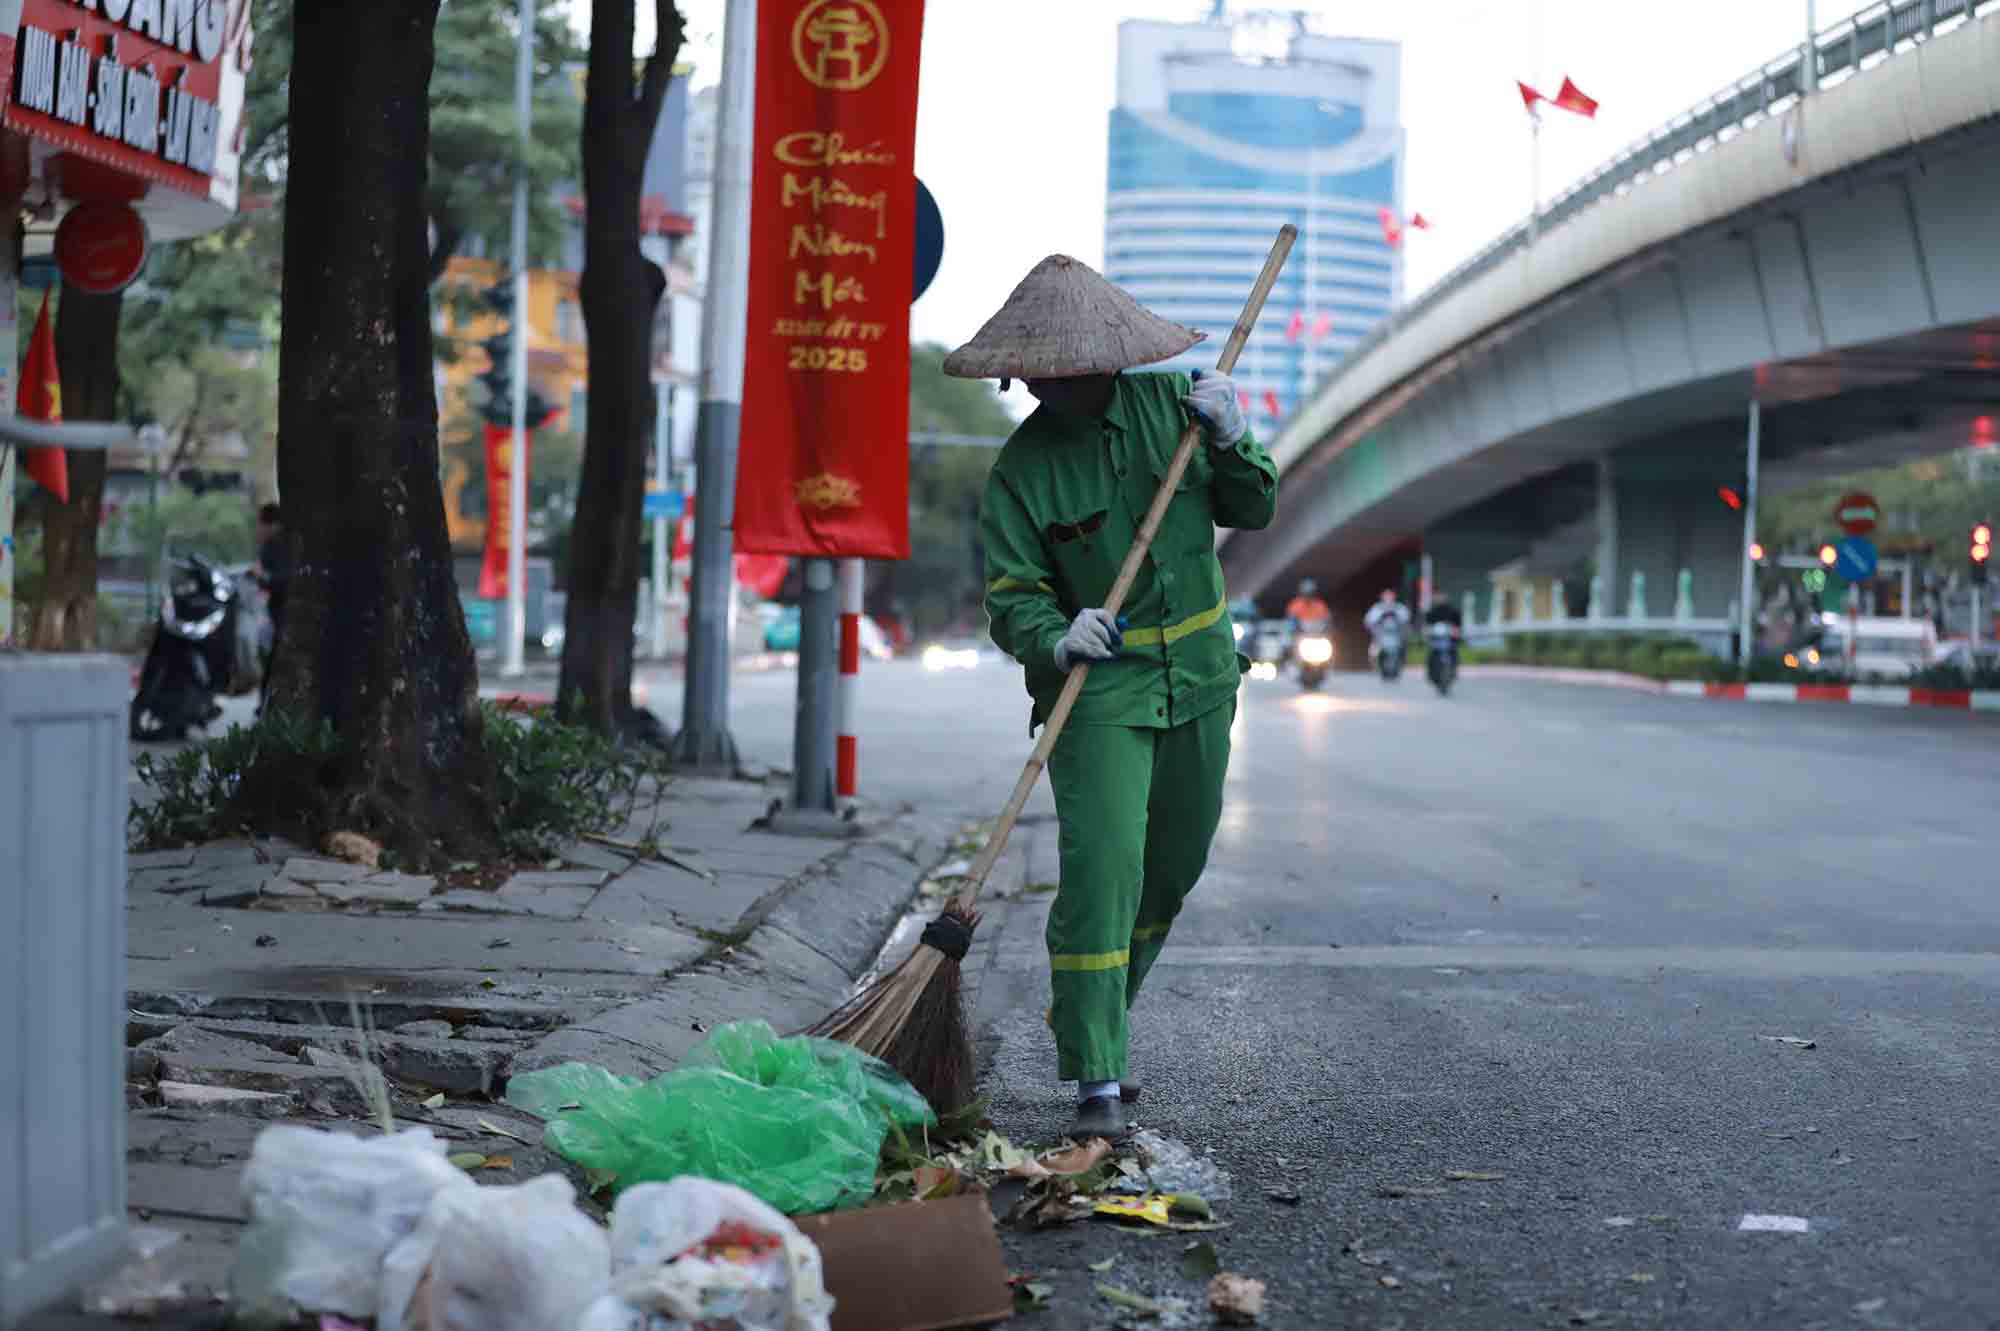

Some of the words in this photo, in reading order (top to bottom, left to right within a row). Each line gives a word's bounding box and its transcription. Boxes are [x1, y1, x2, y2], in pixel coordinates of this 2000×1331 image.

[773, 131, 896, 167] Chúc
[788, 223, 878, 264] Năm
[788, 346, 868, 373] 2025
